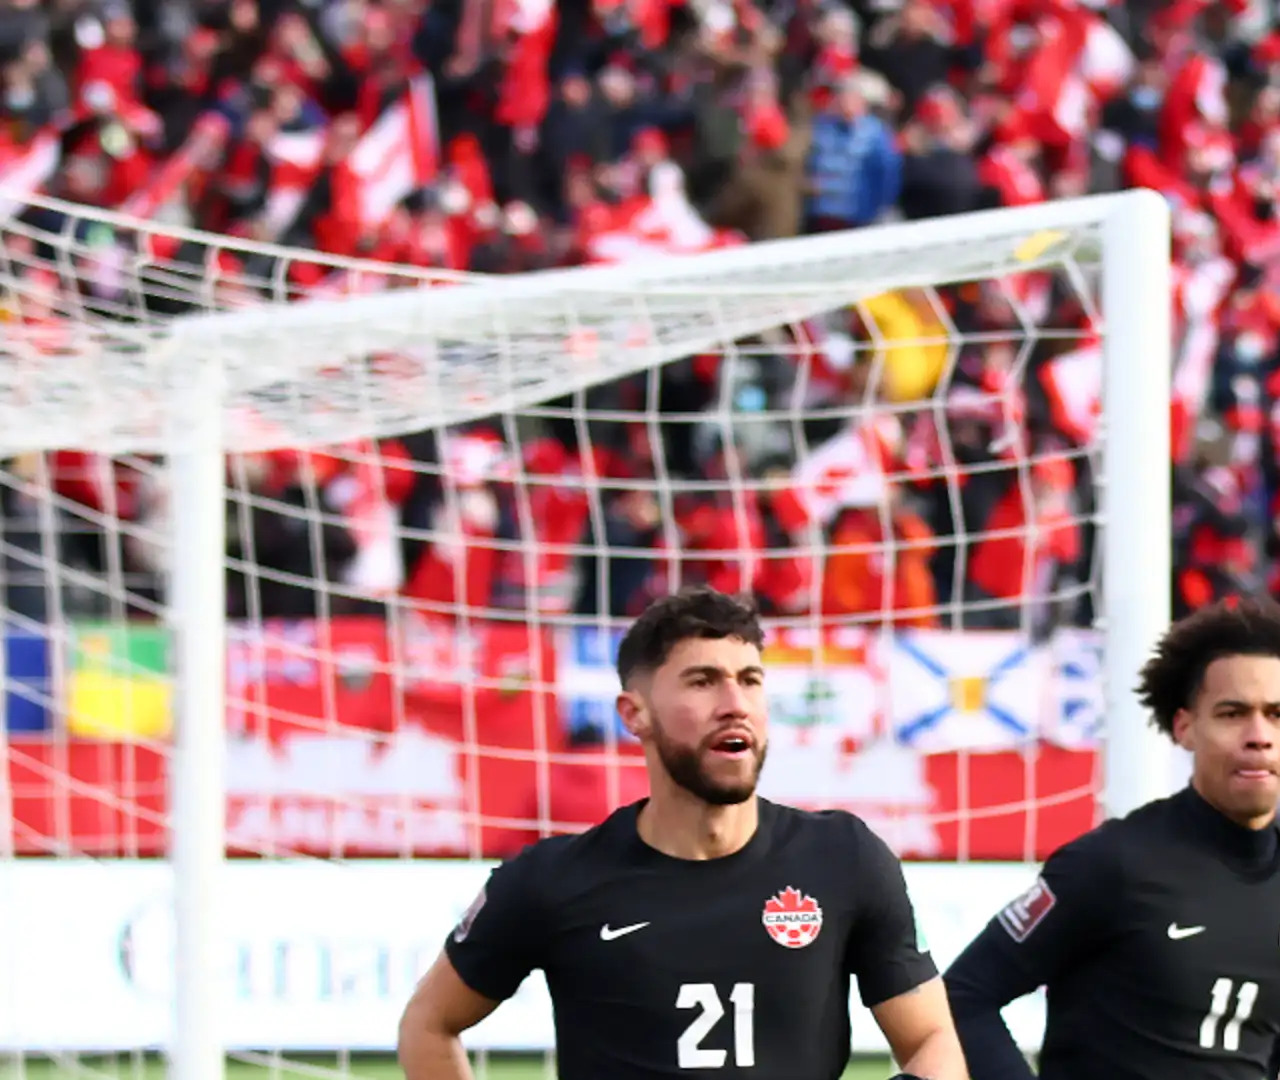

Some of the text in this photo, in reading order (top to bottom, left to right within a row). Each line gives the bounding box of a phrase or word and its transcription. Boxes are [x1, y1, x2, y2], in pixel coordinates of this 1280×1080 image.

[226, 802, 469, 856] ANADA
[765, 913, 819, 923] CANADA
[676, 982, 755, 1069] 21
[1199, 977, 1259, 1052] 11
